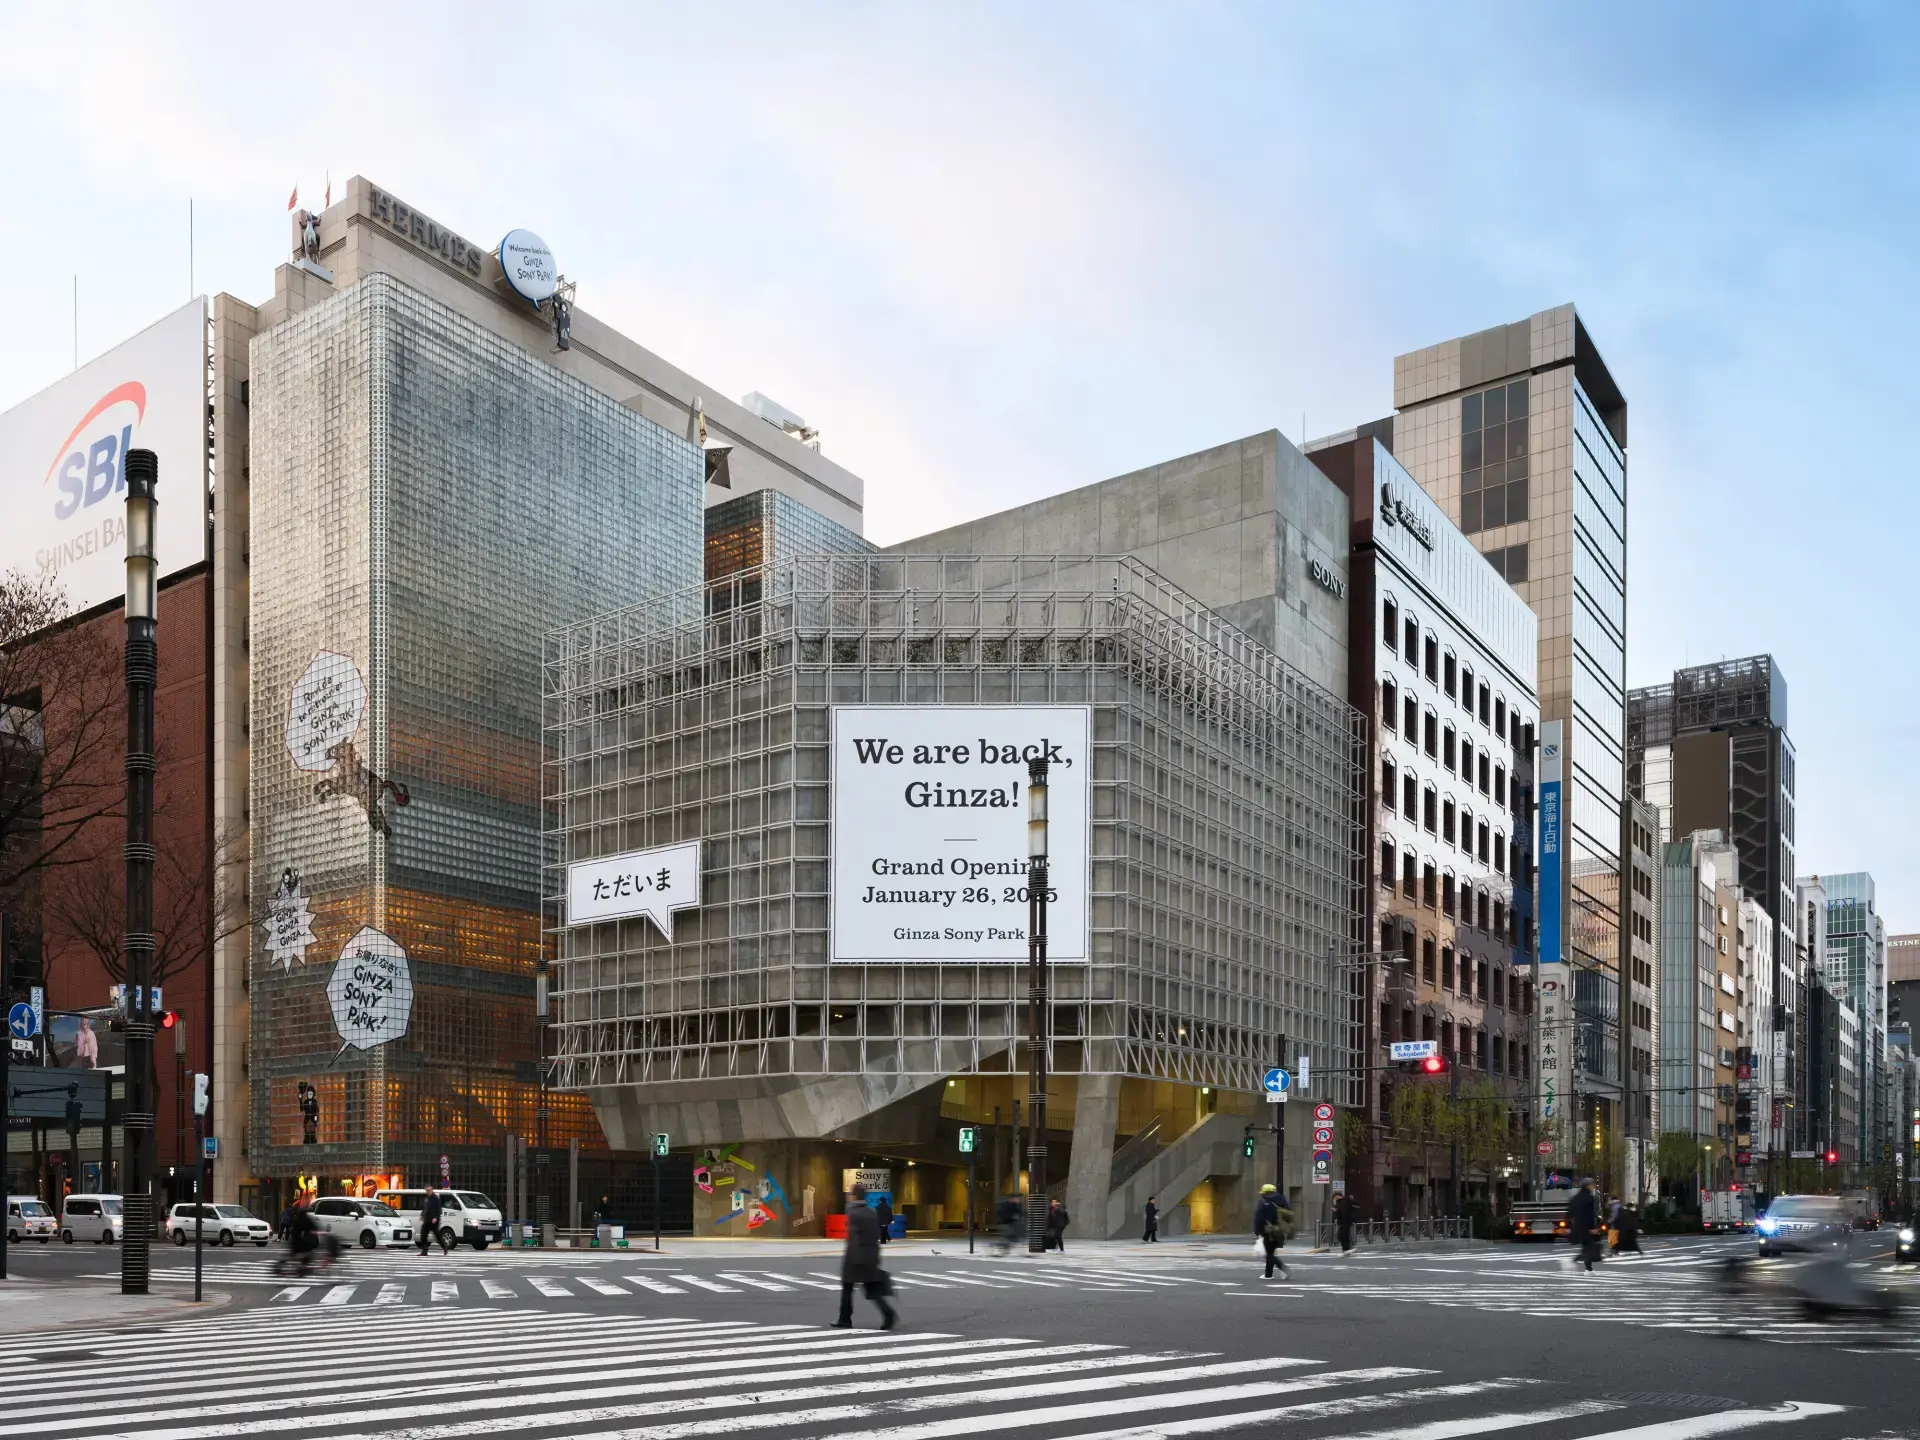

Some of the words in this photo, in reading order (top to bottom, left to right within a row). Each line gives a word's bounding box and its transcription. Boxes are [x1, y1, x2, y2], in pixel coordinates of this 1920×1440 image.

[508, 244, 531, 254] Welcome
[532, 246, 542, 255] back
[523, 255, 543, 268] GINZA
[517, 268, 536, 280] SONY
[537, 269, 553, 282] PARK!
[55, 424, 133, 521] SBI
[35, 528, 99, 578] SHINSEI
[103, 516, 127, 548] BA
[1312, 559, 1346, 599] SONY
[303, 726, 328, 755] SONY
[329, 701, 355, 733] PARK!
[311, 701, 339, 729] GINZA
[853, 738, 904, 764] We
[912, 745, 970, 764] are
[978, 738, 1073, 768] back,
[904, 781, 1019, 808] Ginza!
[1544, 792, 1556, 854] 東京海上日動
[872, 858, 944, 875] Grand
[950, 858, 1050, 879] Openin
[593, 867, 671, 901] ただいま
[862, 886, 957, 907] January
[962, 887, 996, 906] 26,
[1003, 887, 1058, 903] 205
[276, 906, 298, 922] GINZA
[277, 917, 300, 934] GINZA
[893, 927, 940, 940] Ginza
[944, 927, 984, 942] Sony
[987, 927, 1025, 940] Park
[355, 947, 402, 977] お帰りなさい
[354, 965, 393, 994] GINZA
[344, 982, 382, 1008] SONY
[347, 1005, 387, 1032] PARK!
[855, 1171, 882, 1181] Sony
